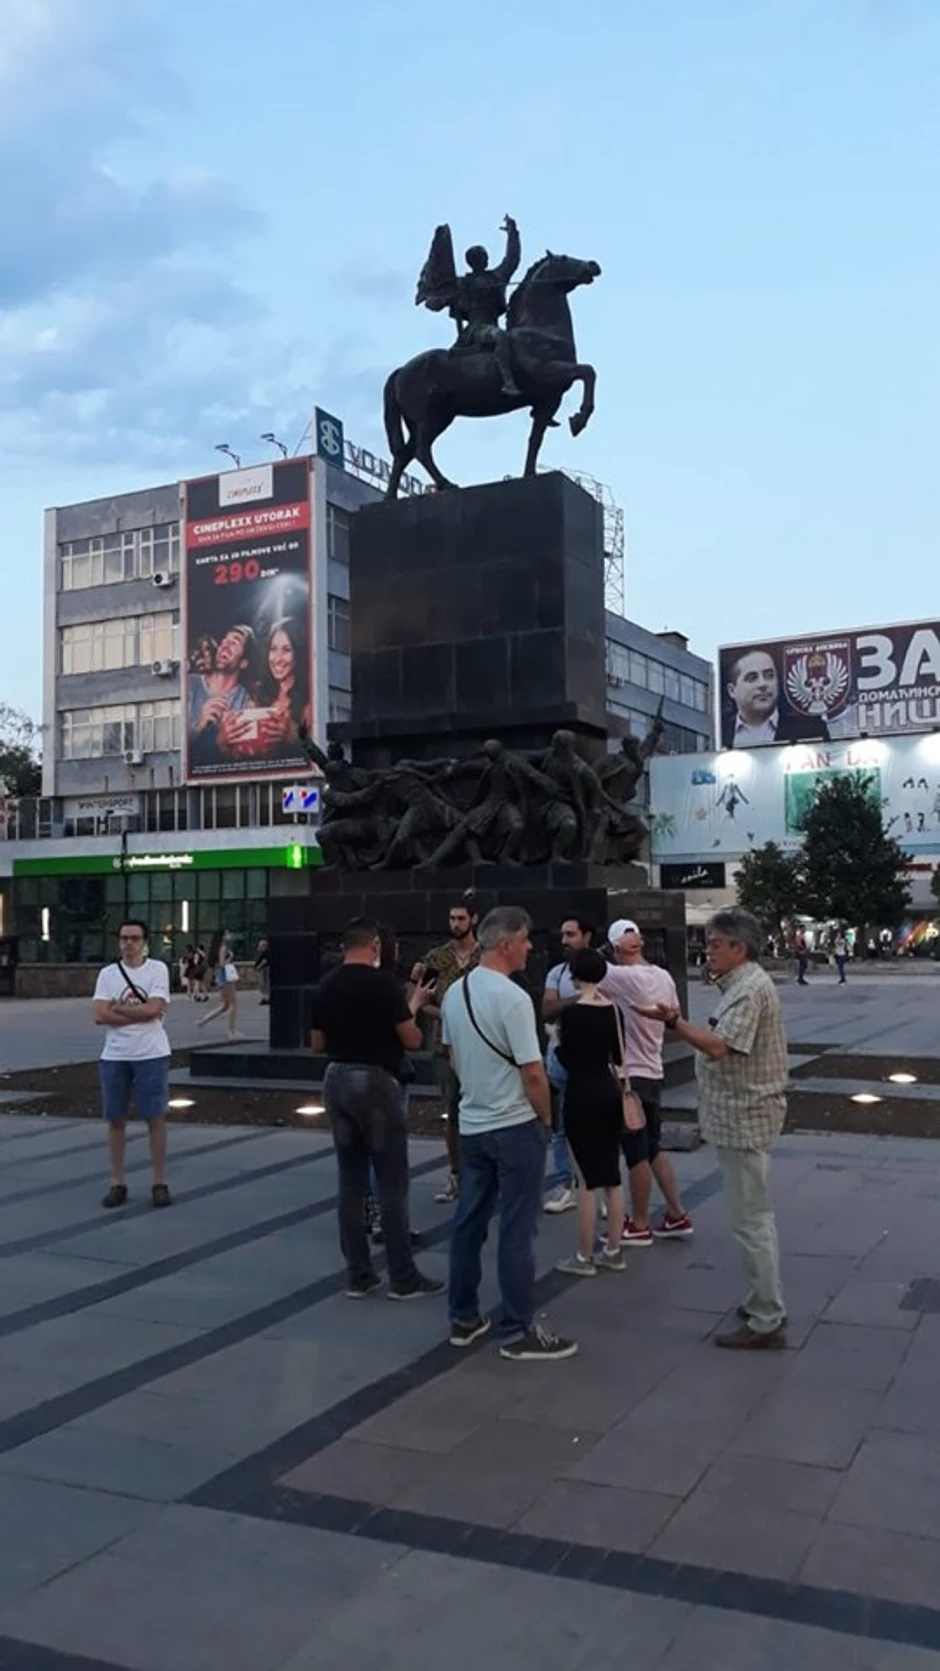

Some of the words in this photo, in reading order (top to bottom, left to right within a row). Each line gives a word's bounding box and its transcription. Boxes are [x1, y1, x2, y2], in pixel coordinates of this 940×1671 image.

[194, 516, 252, 534] CINEPLEXX
[254, 508, 300, 523] UTORAK
[215, 559, 258, 585] 290
[858, 628, 940, 690] ЗА
[858, 698, 940, 728] НИШ
